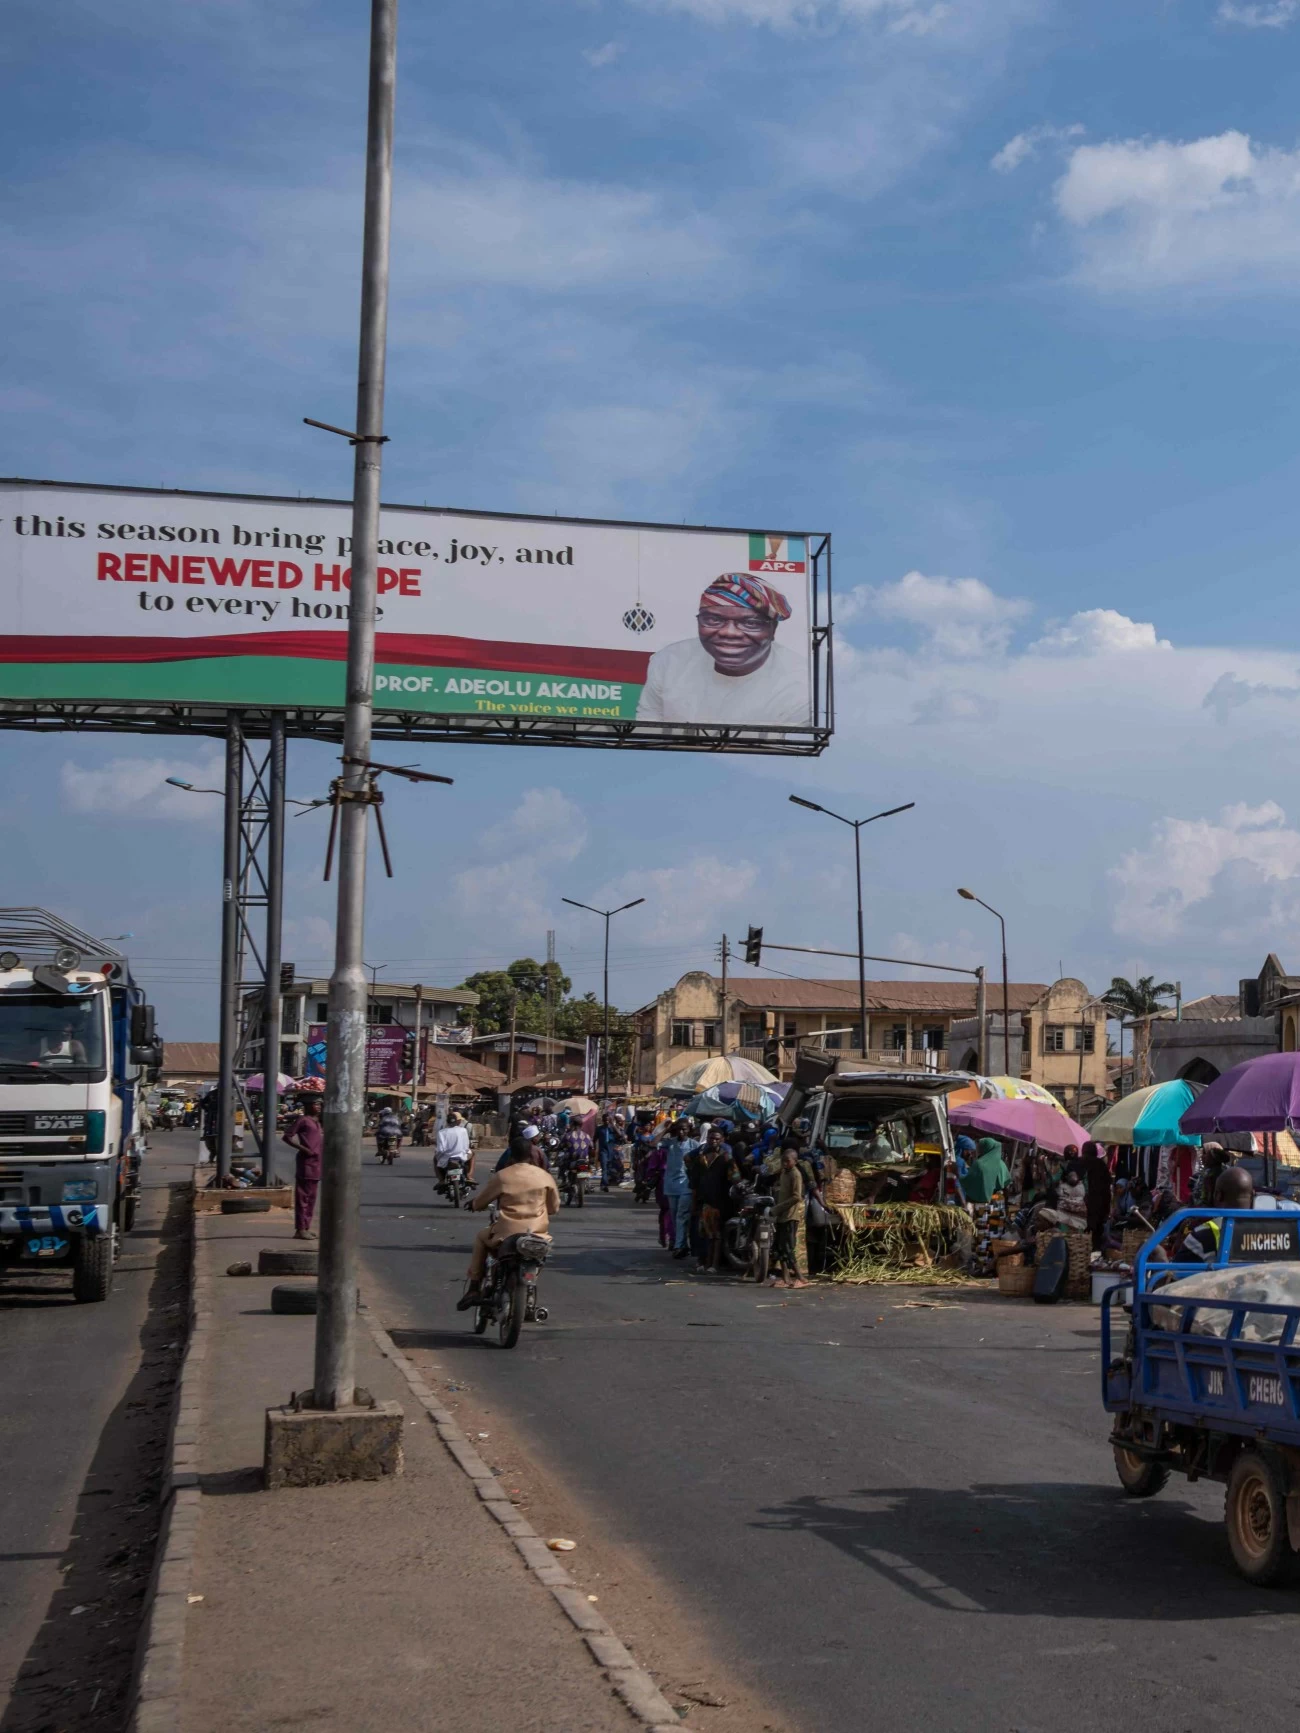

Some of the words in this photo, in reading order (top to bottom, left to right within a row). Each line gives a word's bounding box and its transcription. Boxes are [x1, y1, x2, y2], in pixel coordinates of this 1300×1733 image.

[14, 514, 86, 539] this
[97, 520, 221, 545] season
[232, 524, 326, 556] bring
[337, 533, 439, 561] pace,
[445, 538, 505, 567] joy,
[515, 545, 575, 567] and
[96, 551, 303, 590] RENEWED
[760, 561, 796, 572] APC
[137, 590, 175, 612] to
[186, 596, 281, 622] every
[375, 674, 439, 694] PROF.
[444, 677, 531, 697] ADEOLU
[536, 681, 623, 701] AKANDE
[475, 699, 506, 713] The
[511, 703, 552, 715] voice
[555, 706, 579, 716] we
[582, 706, 621, 717] need
[34, 1121, 85, 1130] DAF
[1240, 1233, 1291, 1251] JINCHENG
[1208, 1370, 1224, 1396] JIN
[1249, 1375, 1284, 1406] CHENG
